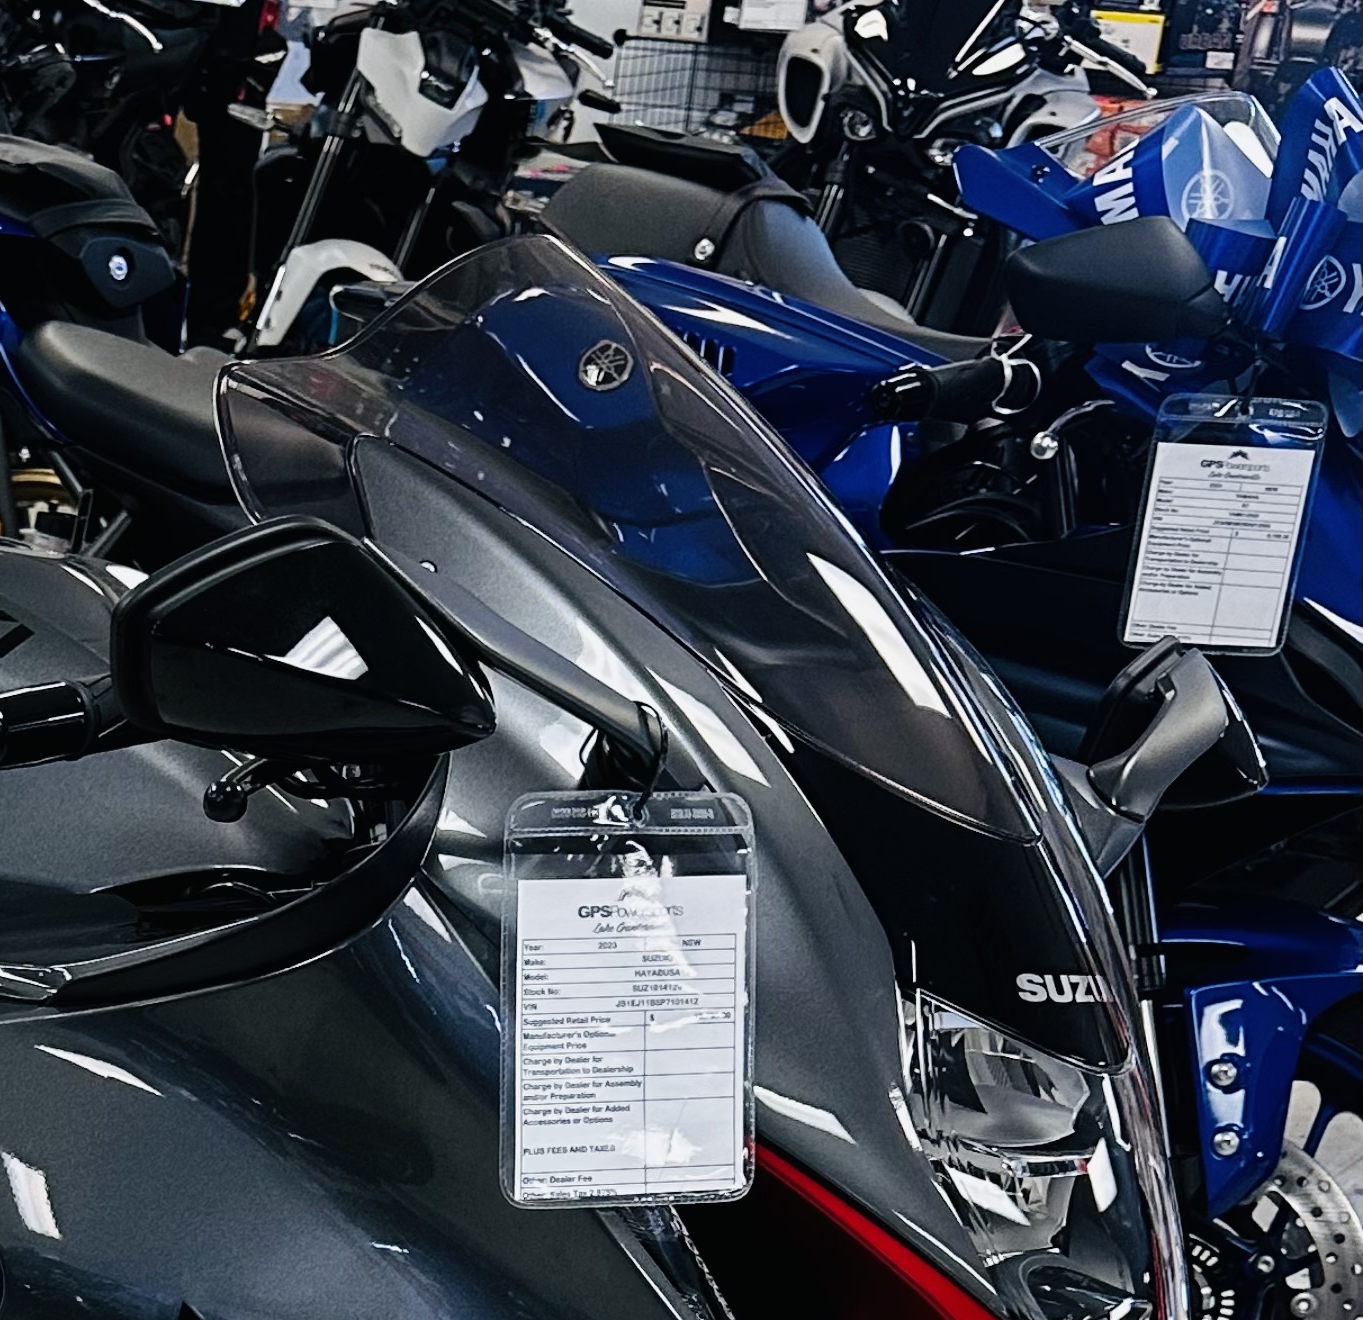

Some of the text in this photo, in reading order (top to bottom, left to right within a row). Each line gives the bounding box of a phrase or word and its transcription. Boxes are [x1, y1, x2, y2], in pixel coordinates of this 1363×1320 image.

[598, 942, 618, 950] 2023
[635, 969, 681, 977] HAYABUSA
[523, 1017, 565, 1027] Suggested
[566, 1016, 589, 1024] Retail
[590, 1016, 611, 1024] Price
[523, 1030, 582, 1040] Manufacturer's
[566, 1042, 587, 1050] Price
[523, 1055, 604, 1066] Charge by Dealer for
[523, 1068, 581, 1077] Transportation
[592, 1065, 634, 1074] Dealership
[523, 1079, 643, 1091] Charge by Dealer for Assembly
[550, 1092, 597, 1101] Preparation
[523, 1104, 631, 1116] Charge by Dealer for Added
[523, 1118, 572, 1127] Accessories
[582, 1116, 614, 1125] Options
[523, 1147, 545, 1156] PLUS
[546, 1146, 568, 1155] FEES
[569, 1146, 588, 1154] AND
[549, 1176, 576, 1184] Dealer
[577, 1174, 593, 1183] Fee
